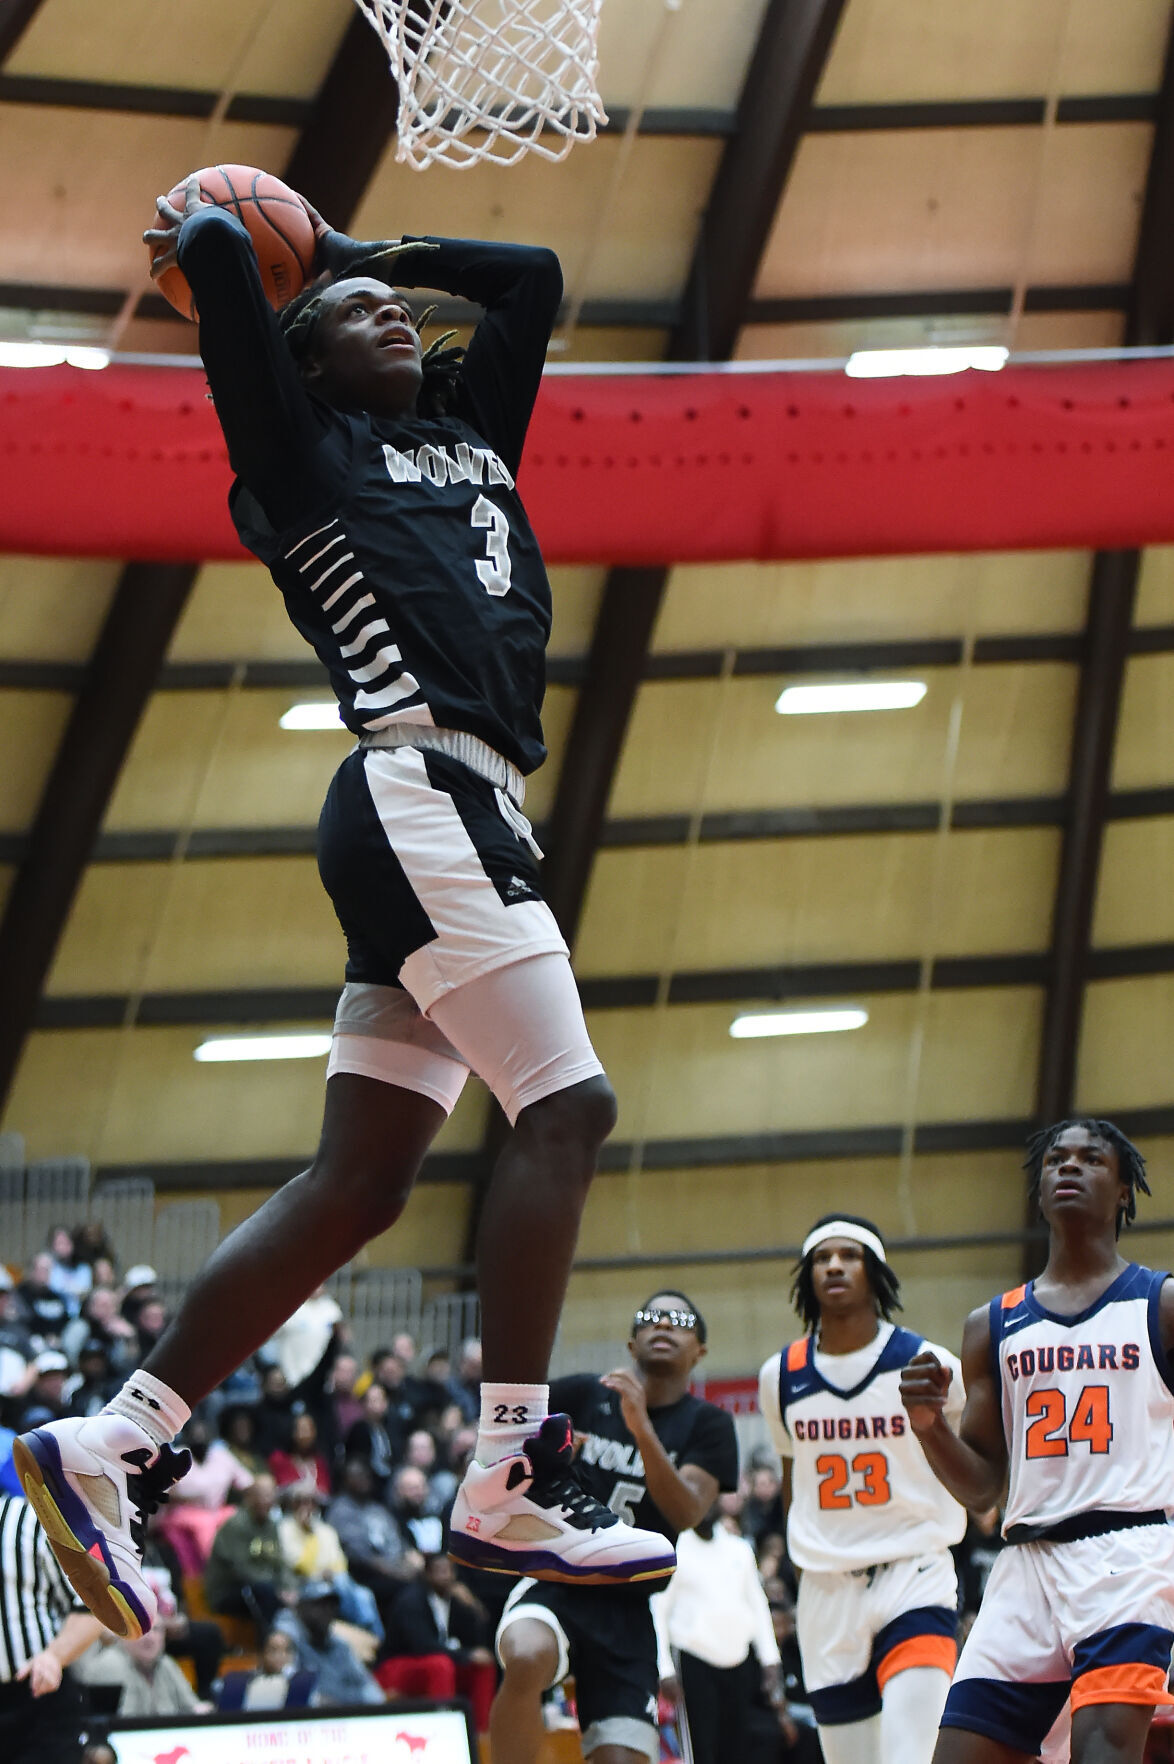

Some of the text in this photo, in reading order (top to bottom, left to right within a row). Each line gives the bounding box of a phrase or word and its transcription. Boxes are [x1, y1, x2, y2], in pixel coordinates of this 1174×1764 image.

[471, 493, 512, 597] 3
[1007, 1343, 1140, 1382] COUGARS
[494, 1404, 528, 1424] 23
[795, 1415, 905, 1441] COUGARS
[1026, 1385, 1113, 1460] 24
[816, 1451, 891, 1510] 23
[466, 1516, 481, 1532] 23
[607, 1481, 646, 1528] 5
